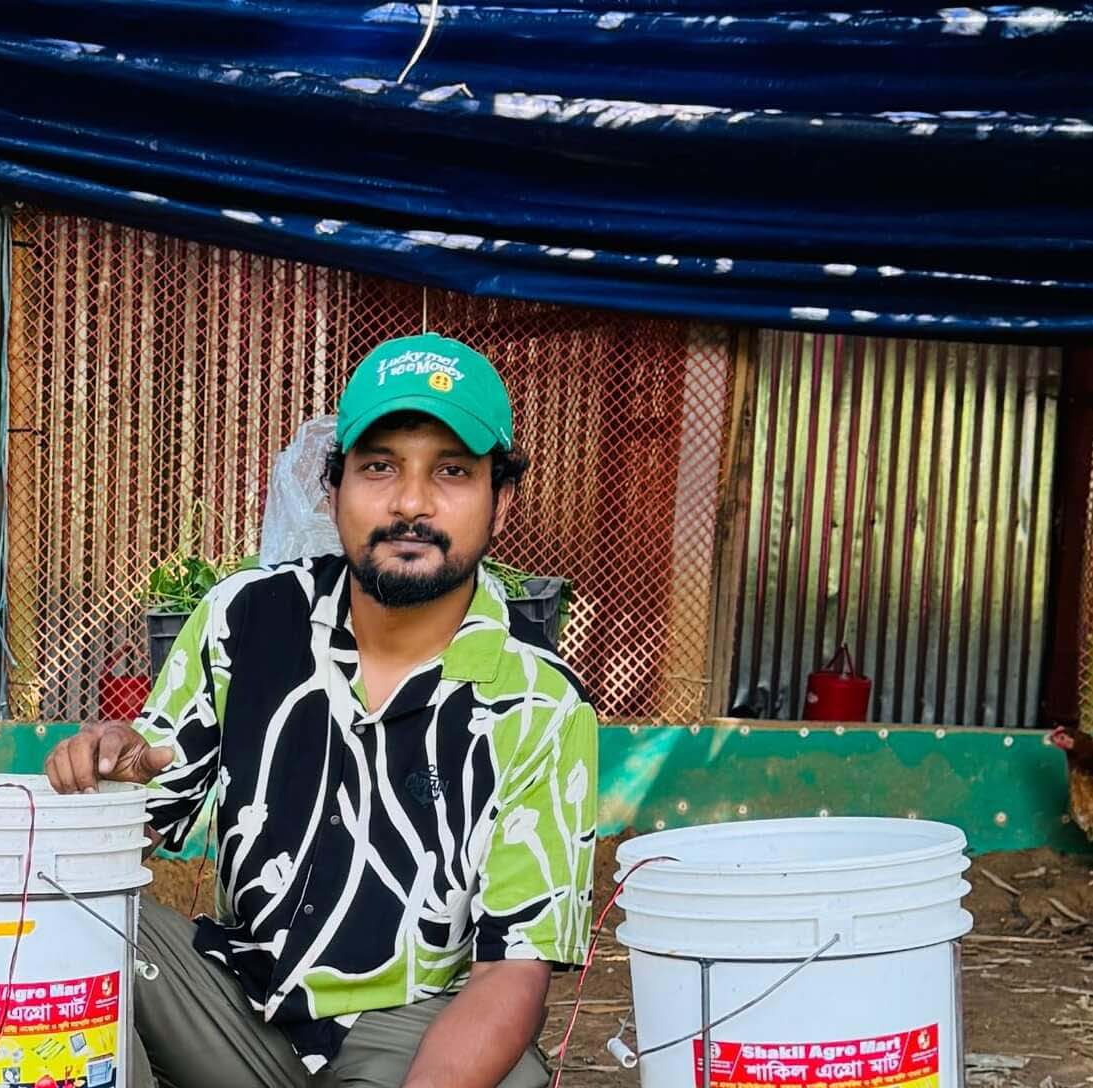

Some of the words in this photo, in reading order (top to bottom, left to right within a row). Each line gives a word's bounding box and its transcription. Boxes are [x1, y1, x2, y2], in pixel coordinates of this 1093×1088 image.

[376, 350, 426, 373] Lucky
[377, 371, 386, 386] I
[414, 360, 466, 381] Money
[1, 986, 46, 1003] Agro
[49, 981, 87, 998] Mart
[56, 995, 87, 1018] মার্ট
[741, 1045, 805, 1060] Shakil
[809, 1044, 857, 1060] Agro
[859, 1036, 901, 1054] Mart
[743, 1060, 808, 1081] শাকিল
[867, 1050, 901, 1073] মার্ট
